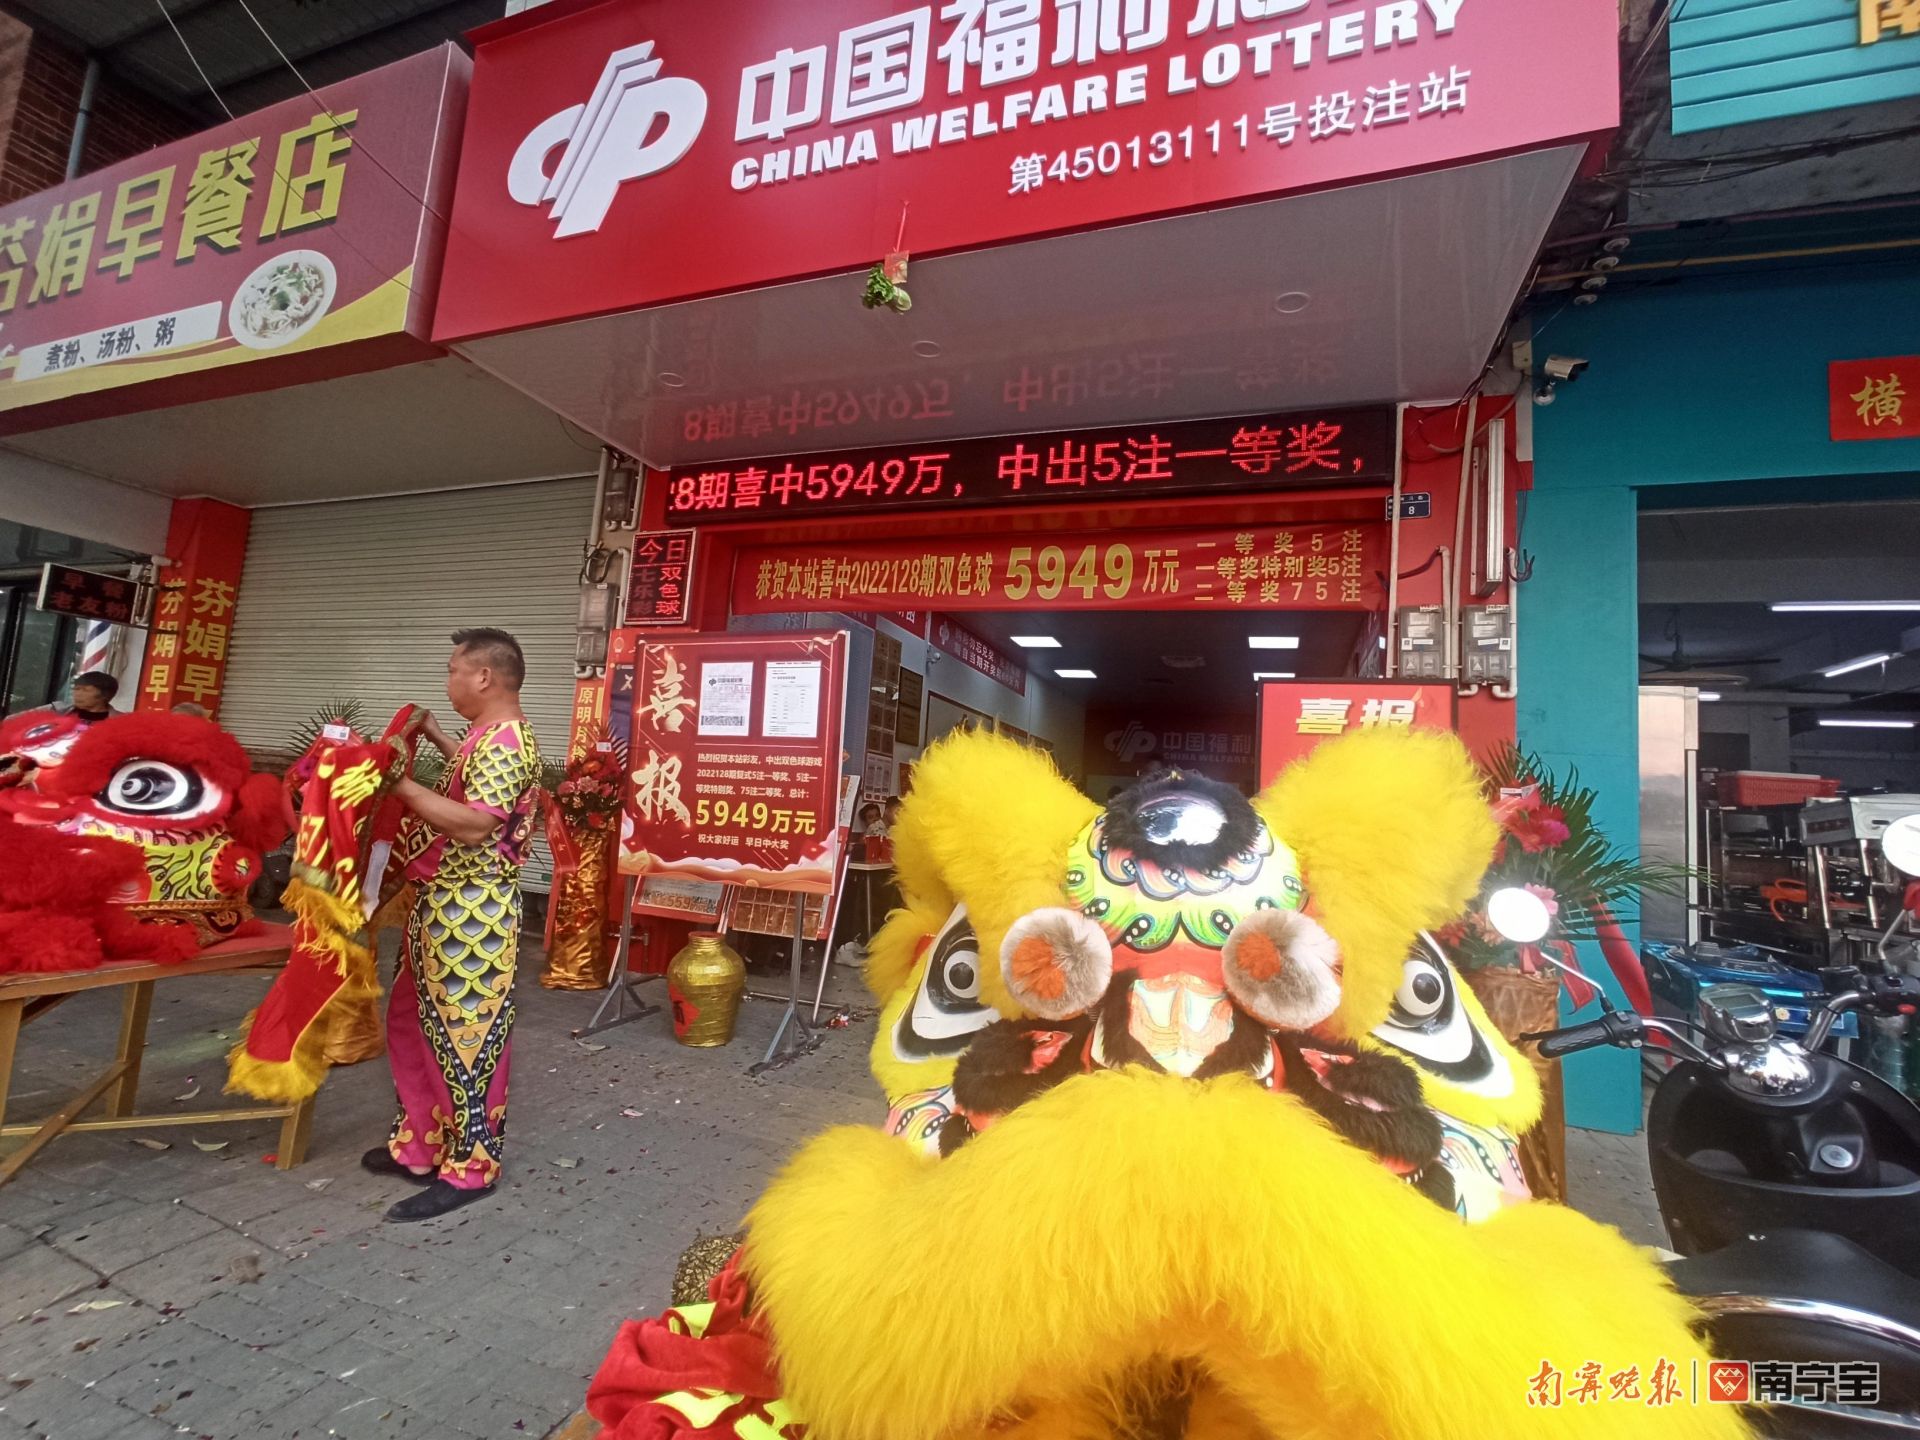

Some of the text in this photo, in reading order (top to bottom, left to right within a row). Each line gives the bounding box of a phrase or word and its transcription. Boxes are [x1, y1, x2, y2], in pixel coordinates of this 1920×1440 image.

[730, 0, 1465, 191] CHINA WELFARE LOTTERY
[1007, 65, 1471, 196] 第45013111号投注站
[1849, 372, 1907, 428] 横
[1408, 506, 1415, 515] 8
[639, 539, 687, 563] 今日
[656, 567, 683, 615] 双色球
[145, 577, 186, 710] 芬娟早
[176, 577, 235, 722] 芬娟早
[695, 799, 817, 835] 5949万元
